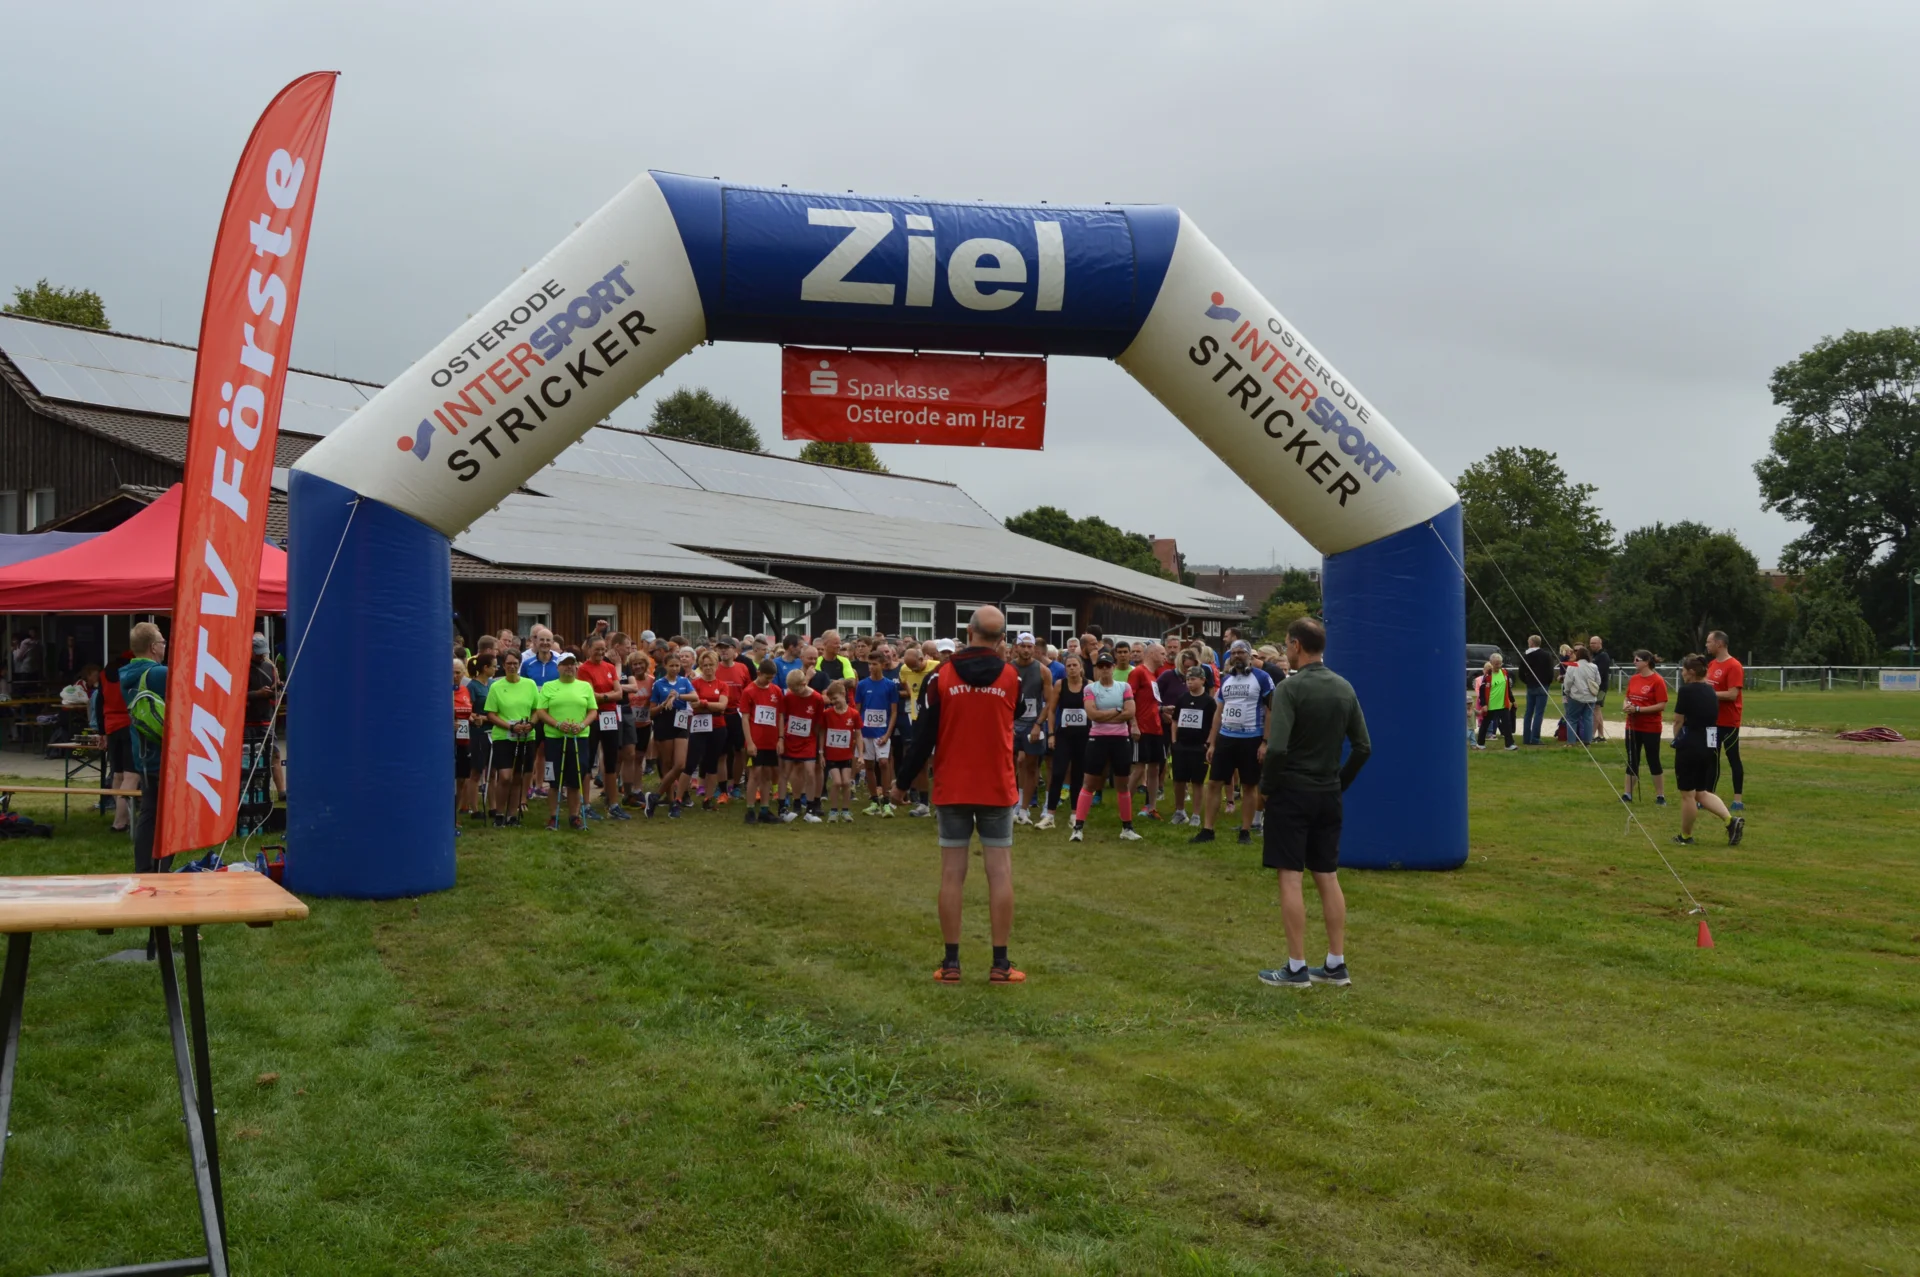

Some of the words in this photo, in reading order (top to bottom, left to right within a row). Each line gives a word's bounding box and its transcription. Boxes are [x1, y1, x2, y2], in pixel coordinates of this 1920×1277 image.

[801, 207, 1066, 311] Ziel
[210, 148, 305, 523] Förste
[431, 278, 566, 388] OSTERODE
[434, 264, 635, 435] INTERSPORT
[1267, 317, 1371, 424] OSTERODE
[447, 310, 657, 482] STRICKER
[847, 379, 950, 401] Sparkasse
[1231, 320, 1397, 483] INTERSPORT
[847, 404, 940, 426] Osterode
[946, 411, 976, 428] am
[982, 410, 1025, 430] Harz
[1189, 335, 1361, 507] STRICKER
[186, 539, 239, 817] MTV
[949, 684, 971, 696] MTV
[693, 719, 709, 728] 216
[760, 711, 775, 721] 173
[867, 714, 884, 723] 035
[1065, 714, 1084, 723] 008
[1181, 713, 1199, 723] 252
[1225, 708, 1242, 718] 186
[458, 724, 469, 734] 23
[790, 721, 807, 732] 254
[830, 734, 847, 743] 174
